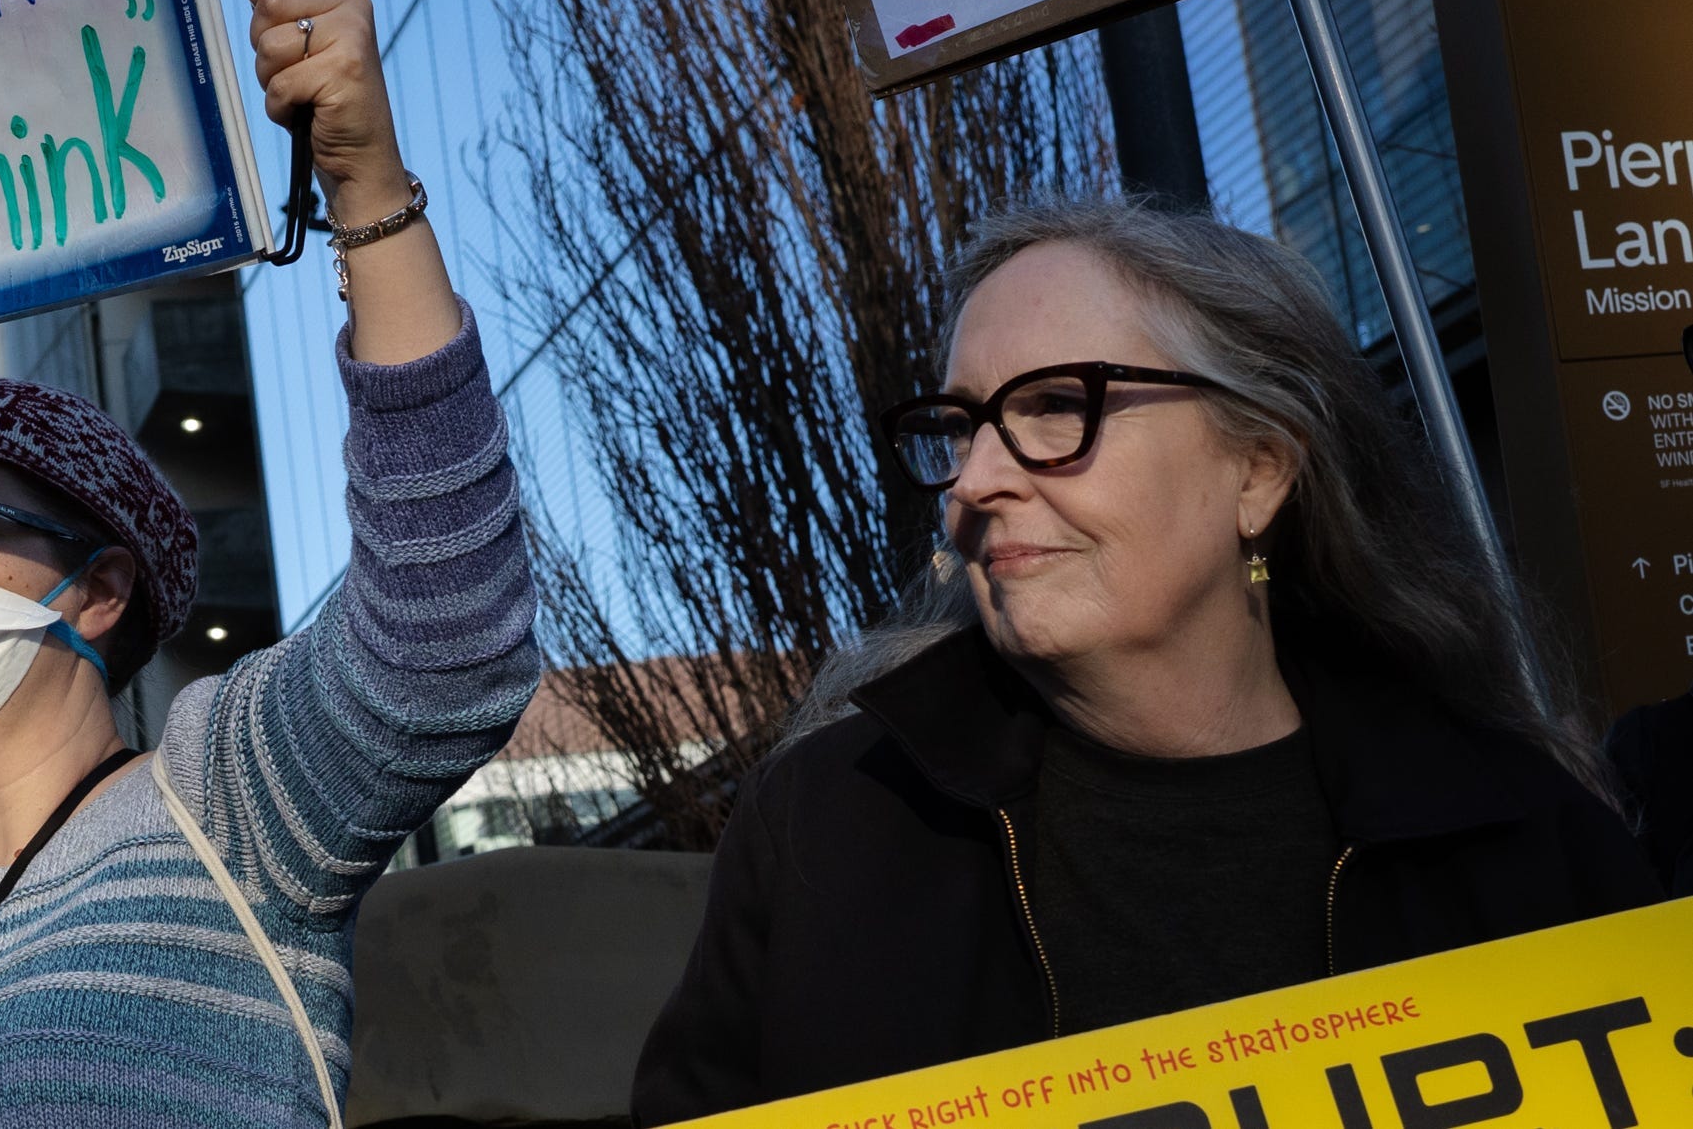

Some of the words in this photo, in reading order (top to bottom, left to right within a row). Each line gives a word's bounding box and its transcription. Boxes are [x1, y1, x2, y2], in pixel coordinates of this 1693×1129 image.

[183, 5, 192, 23] SIDE
[187, 24, 196, 41] THIS
[191, 42, 202, 67] ERASE
[1586, 285, 1692, 315] Mission
[1648, 394, 1674, 410] NO
[1655, 450, 1693, 468] WIN
[1002, 1076, 1054, 1109] OFF
